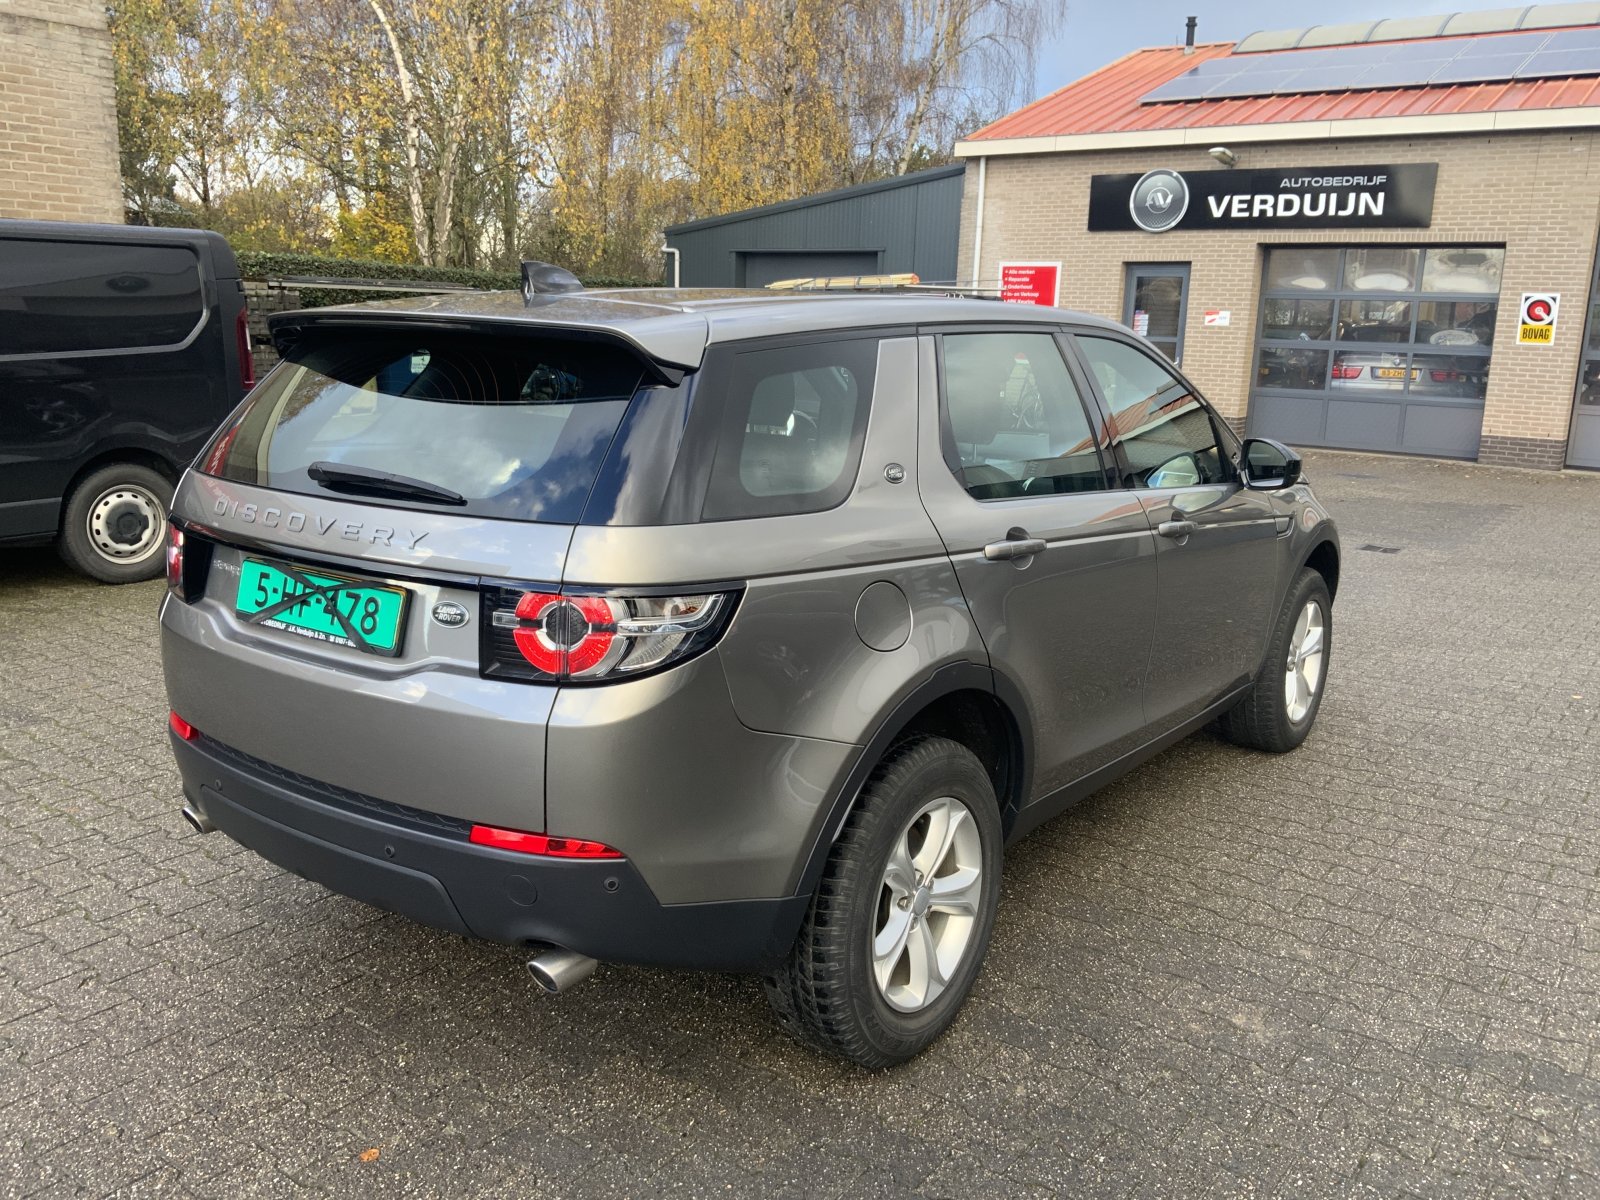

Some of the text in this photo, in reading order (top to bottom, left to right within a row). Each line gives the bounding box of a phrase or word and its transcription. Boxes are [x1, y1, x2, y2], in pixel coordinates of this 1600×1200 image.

[1280, 175, 1387, 188] AUTOBEDRIJF
[1207, 191, 1386, 218] VERDUIJN
[1522, 327, 1550, 340] BOVAG
[214, 497, 430, 550] DISCOVERY
[254, 572, 380, 636] 5-HF-478
[437, 612, 462, 623] ROVER
